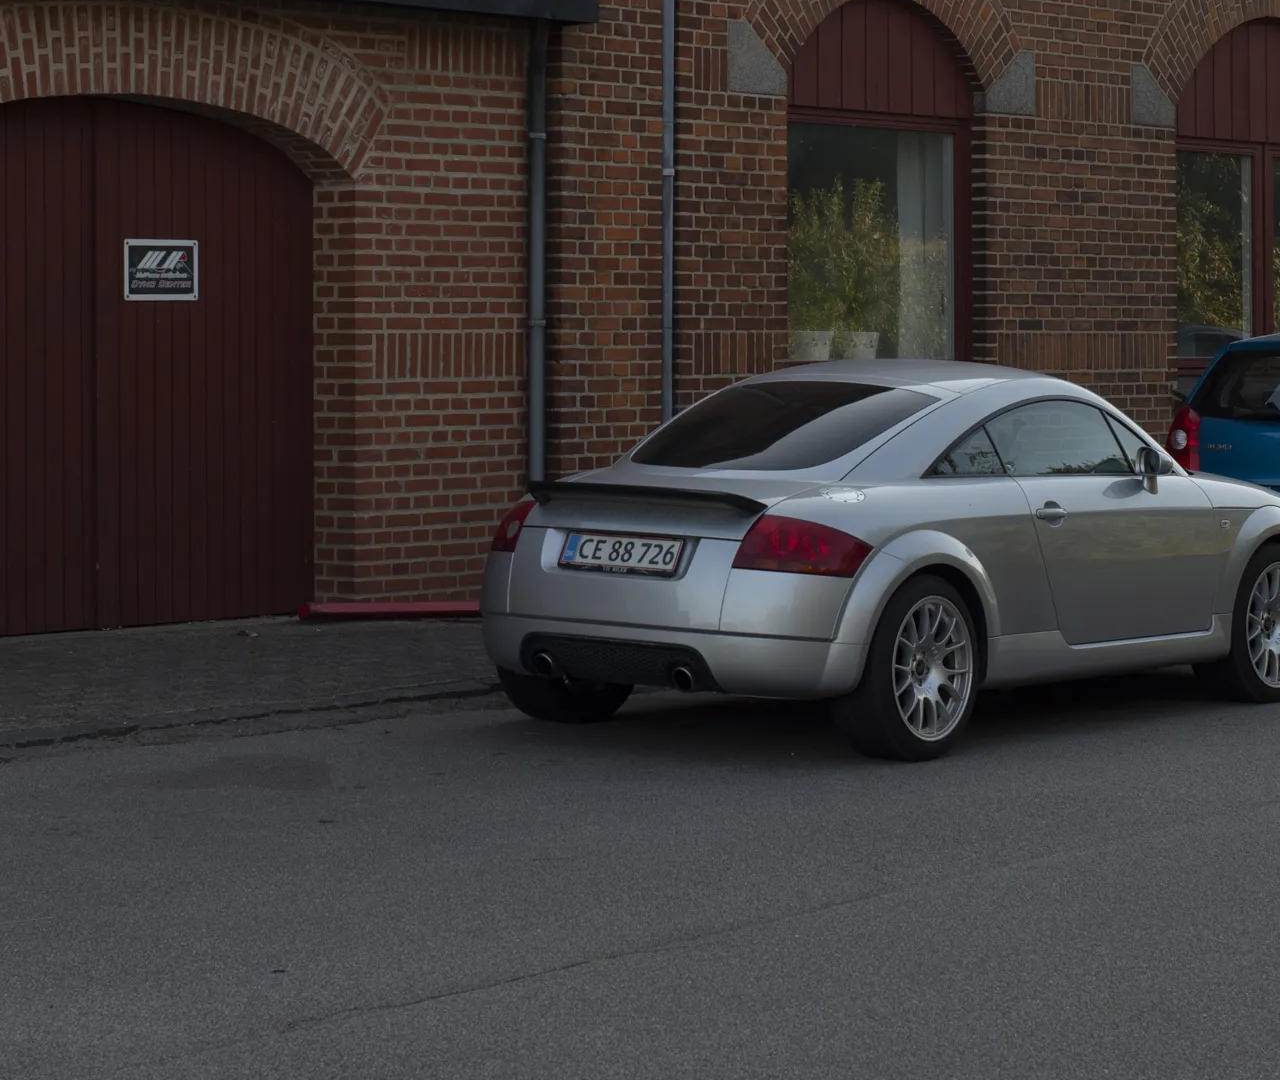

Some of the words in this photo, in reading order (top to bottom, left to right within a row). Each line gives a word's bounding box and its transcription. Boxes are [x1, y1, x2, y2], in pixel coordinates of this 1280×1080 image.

[158, 280, 192, 289] CENTER
[578, 538, 607, 560] CE
[608, 540, 635, 563] 88
[637, 542, 675, 566] 726
